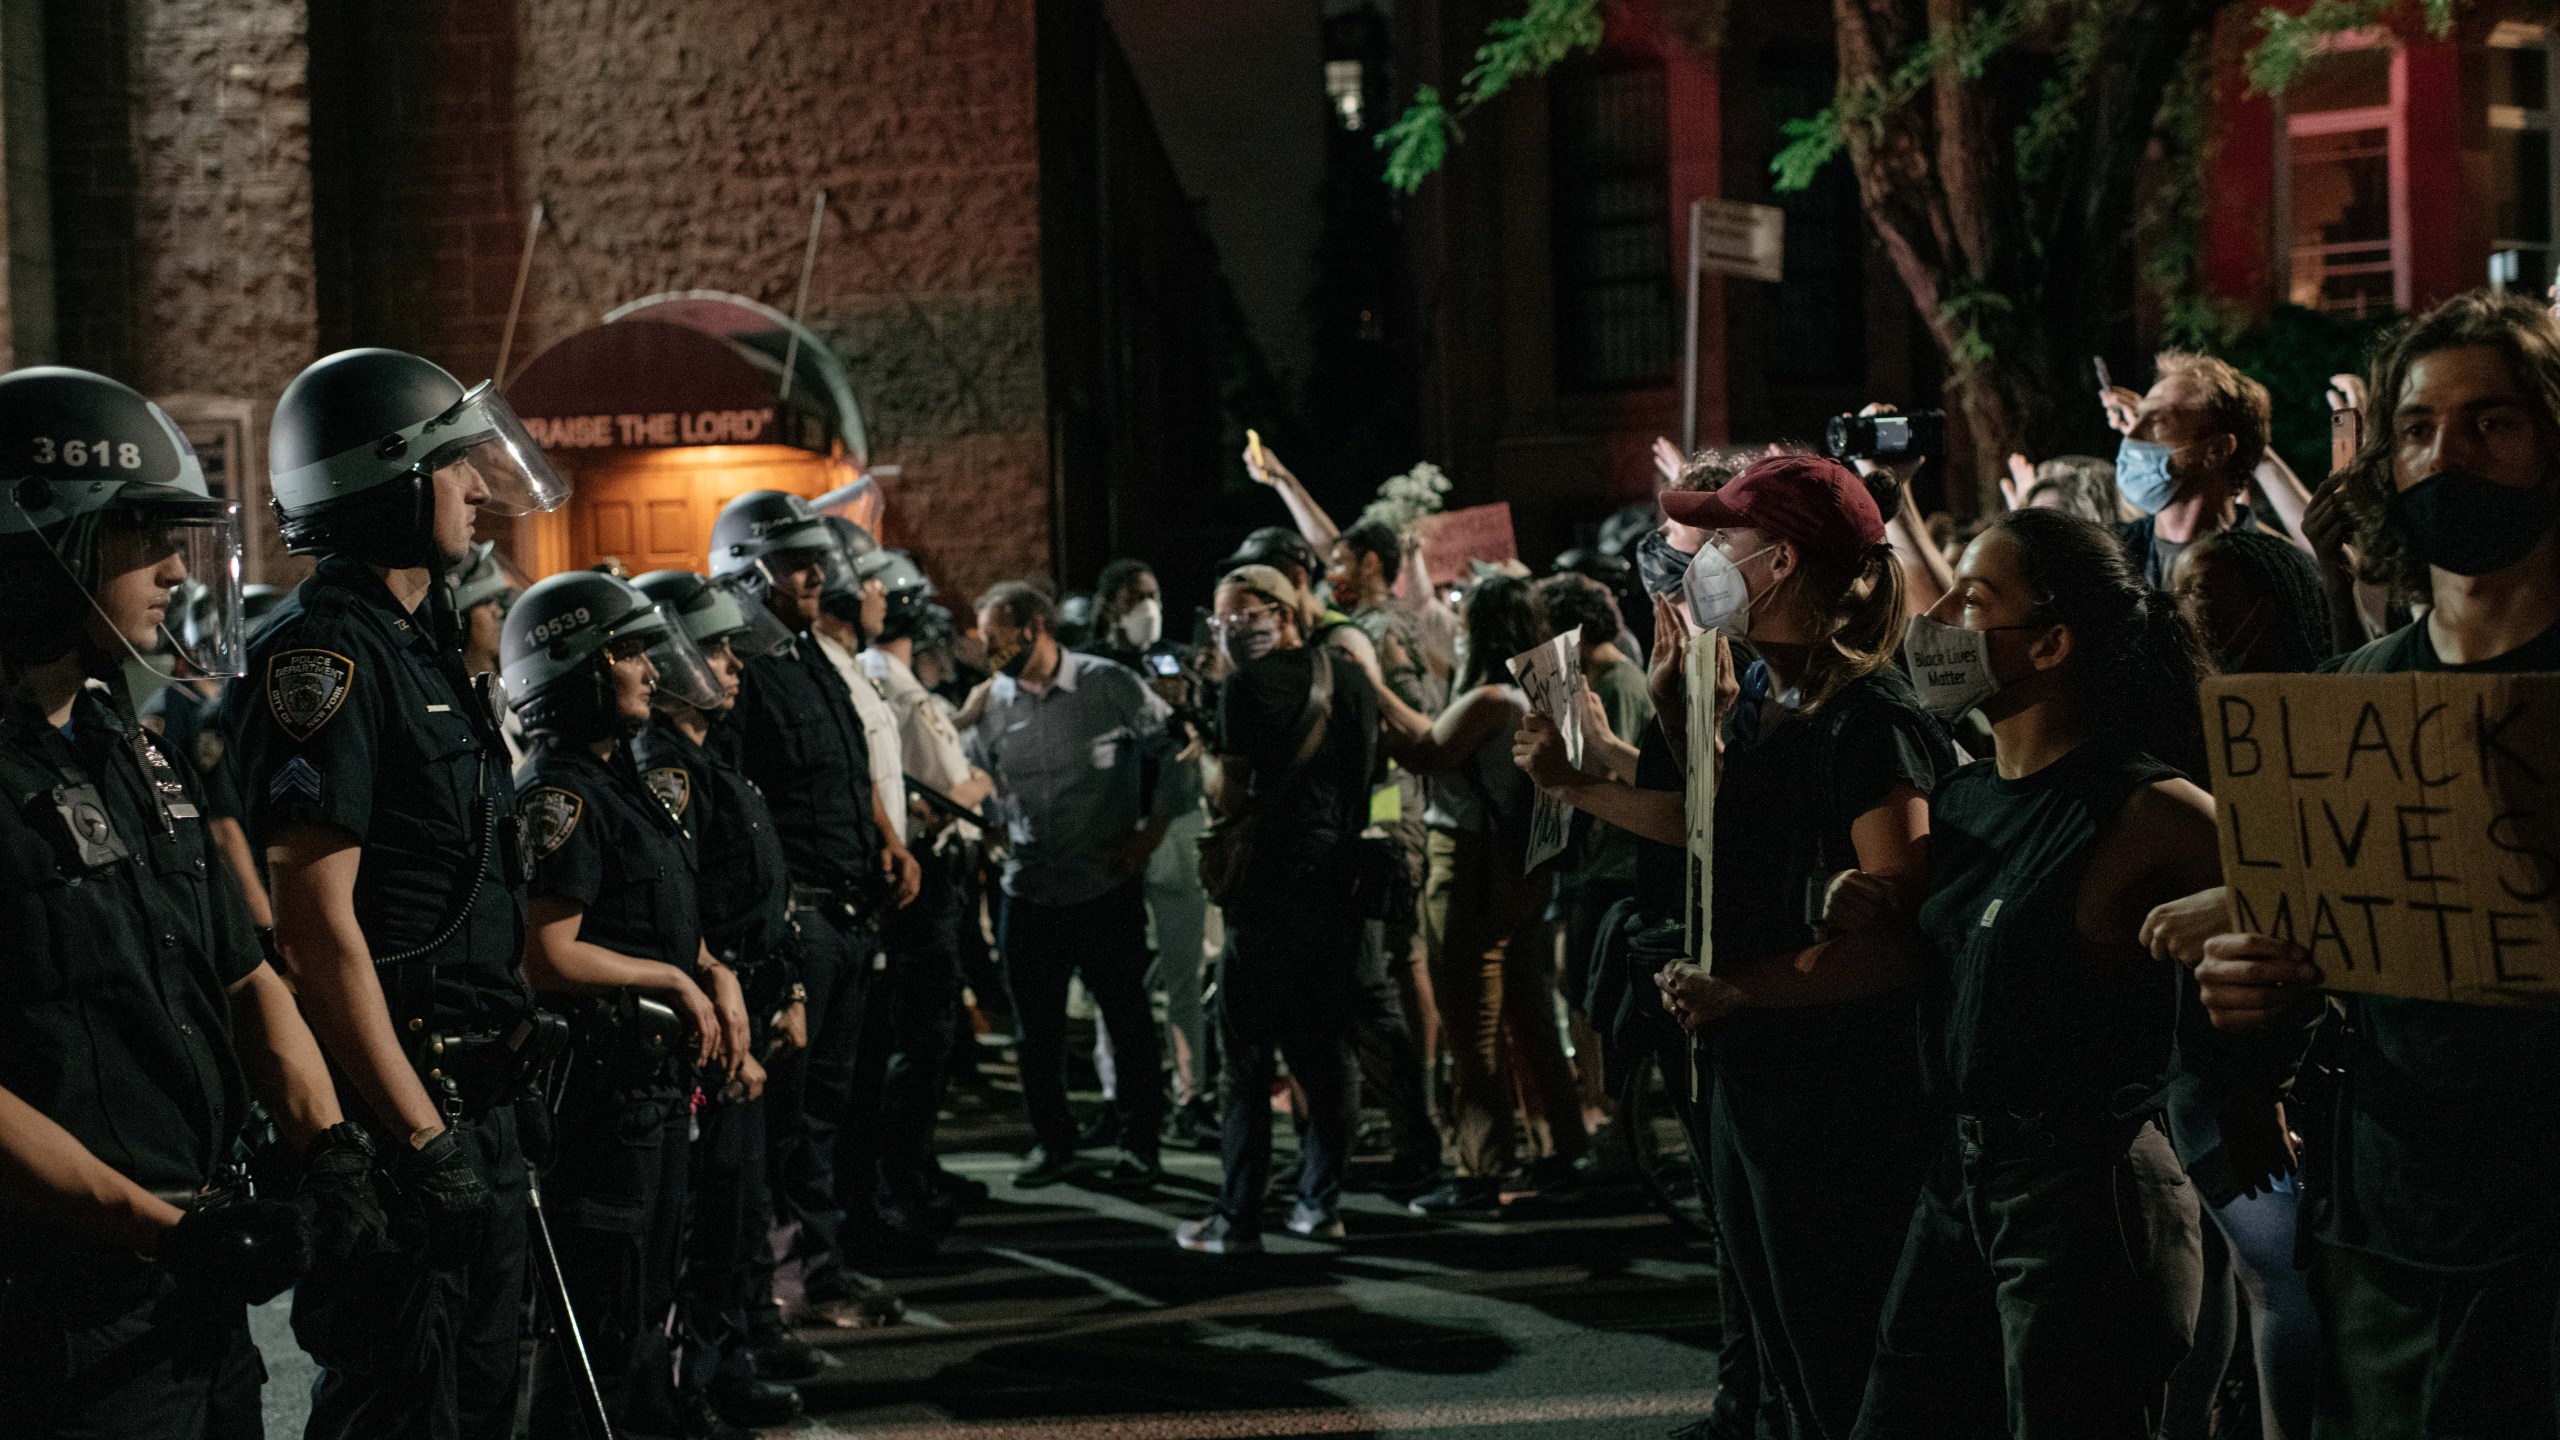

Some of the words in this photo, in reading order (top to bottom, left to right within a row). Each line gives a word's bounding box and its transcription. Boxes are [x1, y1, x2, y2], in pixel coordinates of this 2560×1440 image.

[616, 413, 677, 446] THE
[32, 437, 142, 469] 3618
[524, 607, 591, 647] 19539
[290, 655, 332, 667] POLICE
[1914, 649, 1945, 667] Black
[1946, 648, 1977, 665] Lives
[275, 663, 344, 680] DEPARTMENT
[1927, 671, 1966, 687] Matter
[271, 689, 285, 711] CITY
[323, 685, 345, 710] YORK
[2219, 694, 2546, 788] BLACK
[2230, 798, 2560, 902] LIVES
